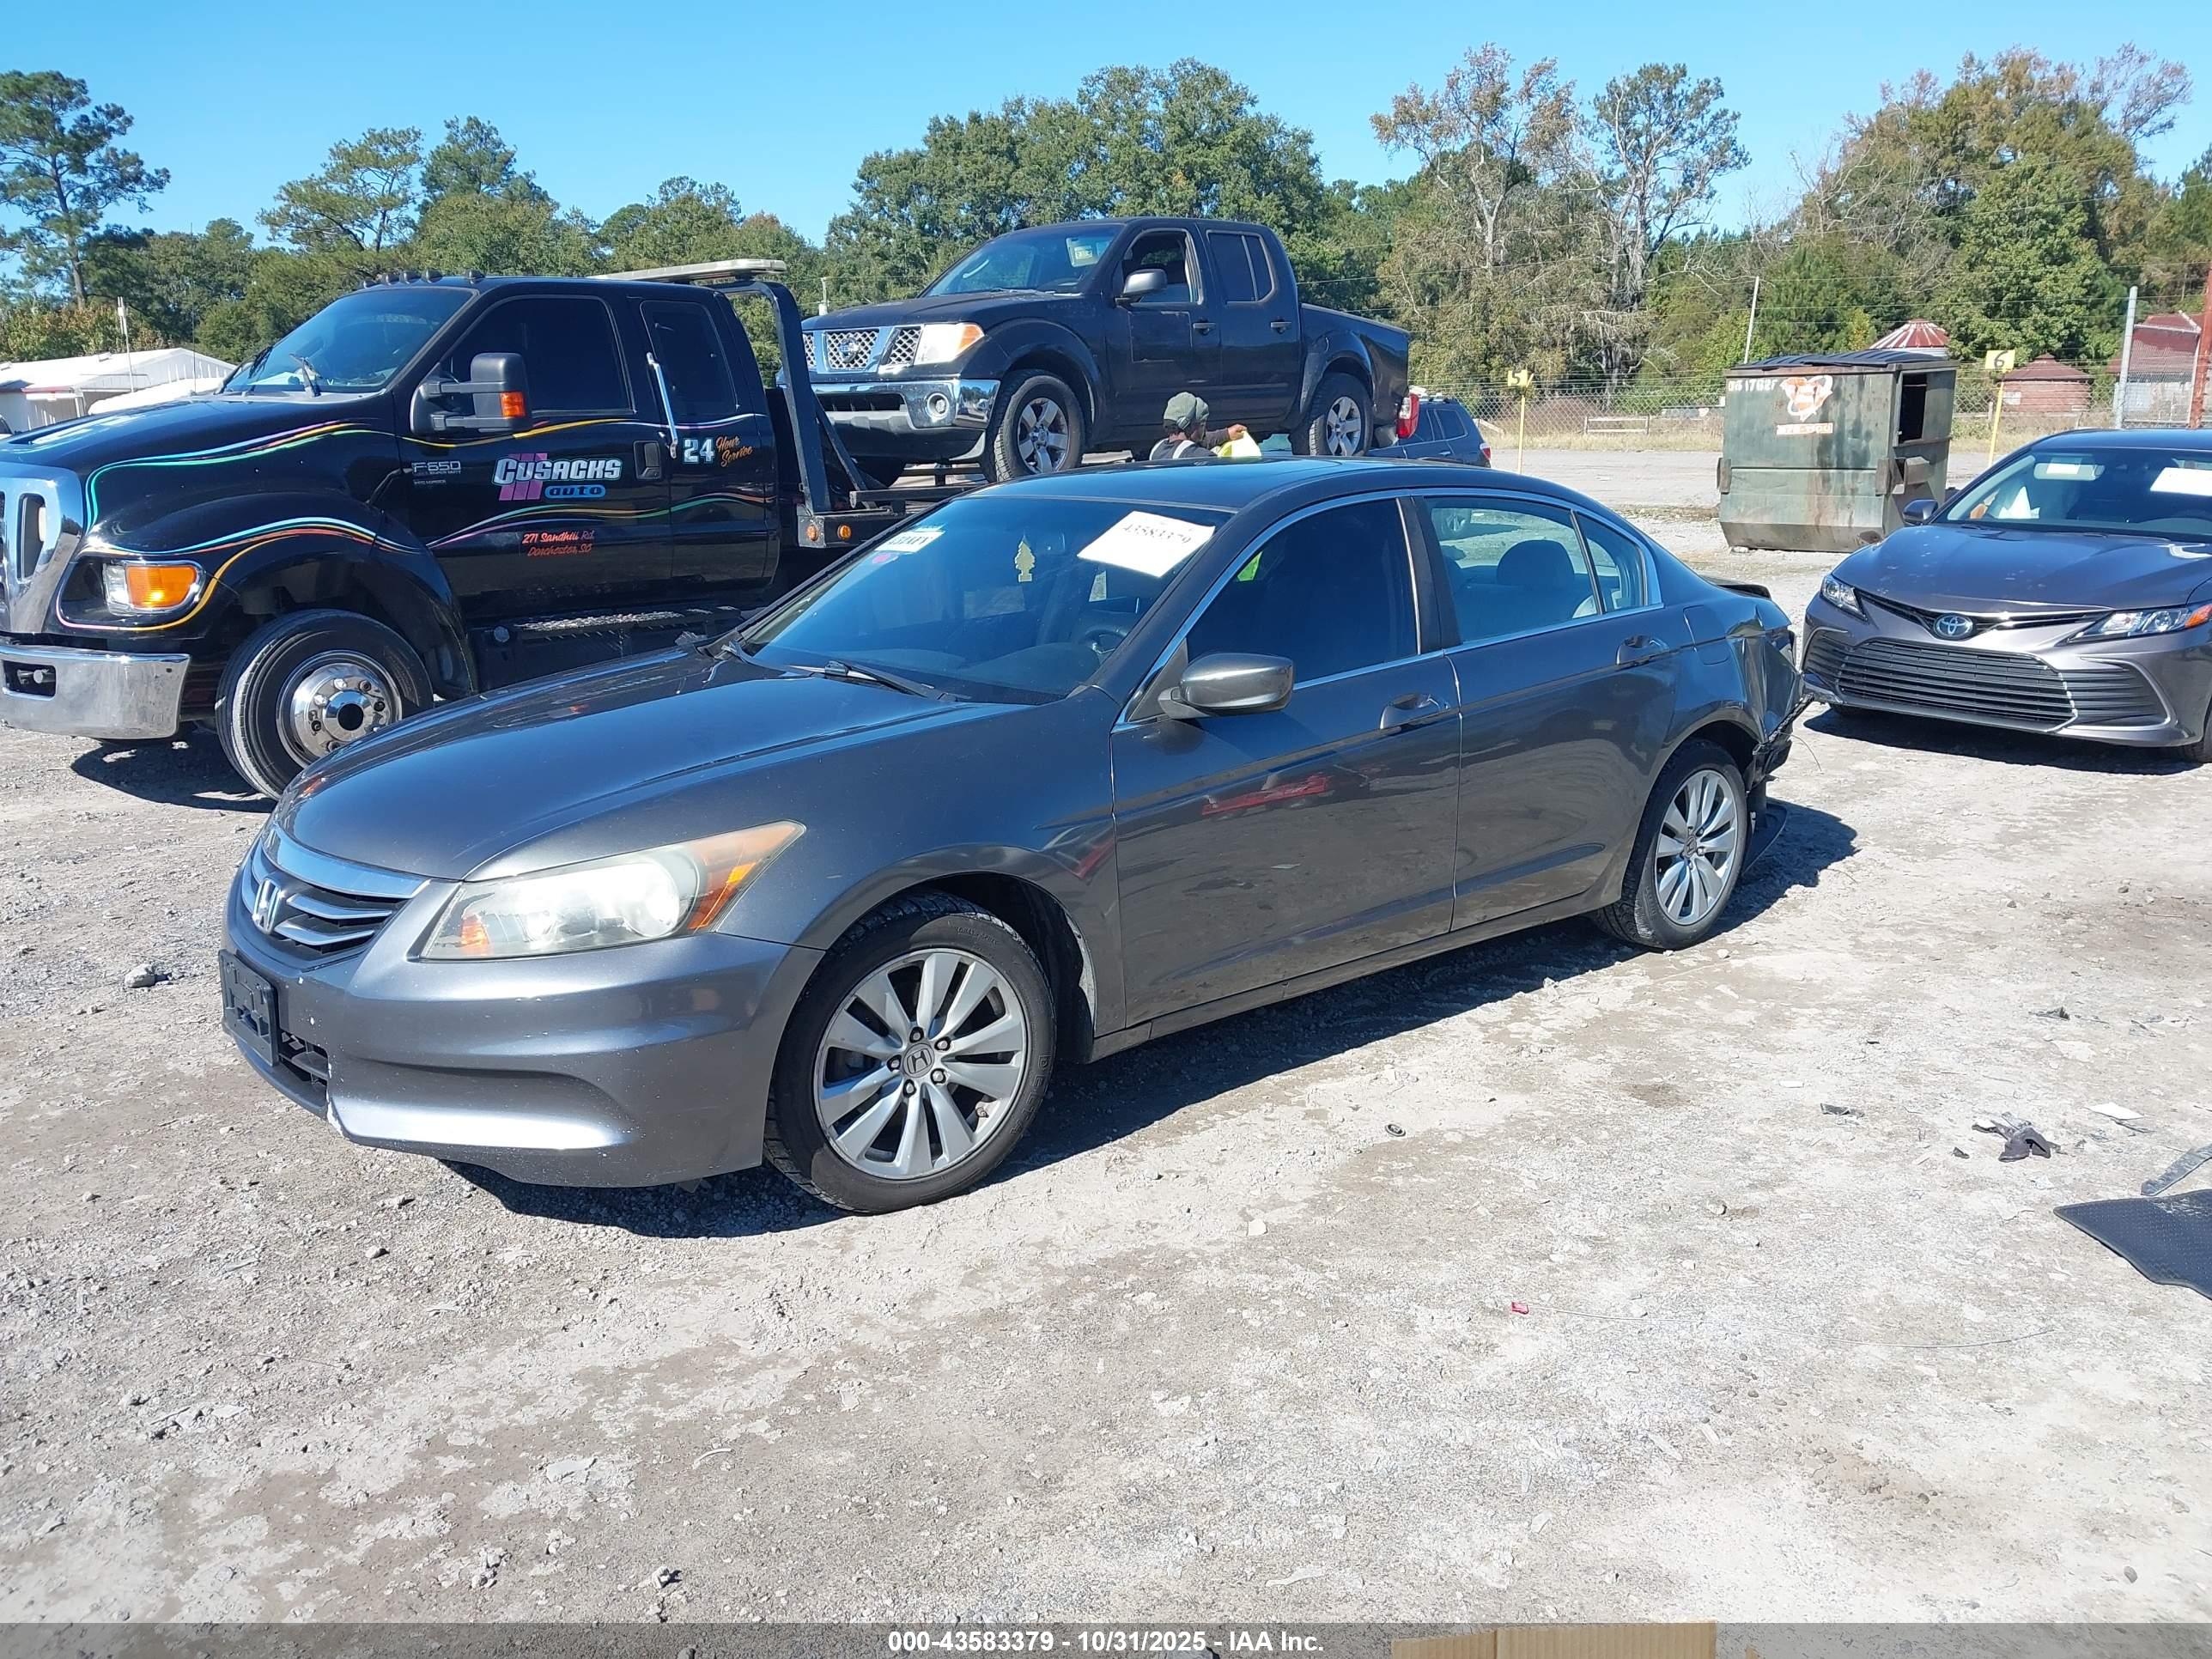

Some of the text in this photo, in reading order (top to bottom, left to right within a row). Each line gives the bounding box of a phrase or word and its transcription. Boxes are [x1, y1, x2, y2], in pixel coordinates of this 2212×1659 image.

[1994, 350, 2008, 369] 6
[1511, 369, 1521, 385] 5
[684, 435, 740, 462] 24 Hour
[720, 446, 753, 468] Service
[493, 458, 623, 486] CUSACKS
[548, 485, 603, 497] auto
[522, 532, 539, 544] 271
[540, 531, 580, 543] Sandhill
[1010, 1054, 1052, 1135] DELTA
